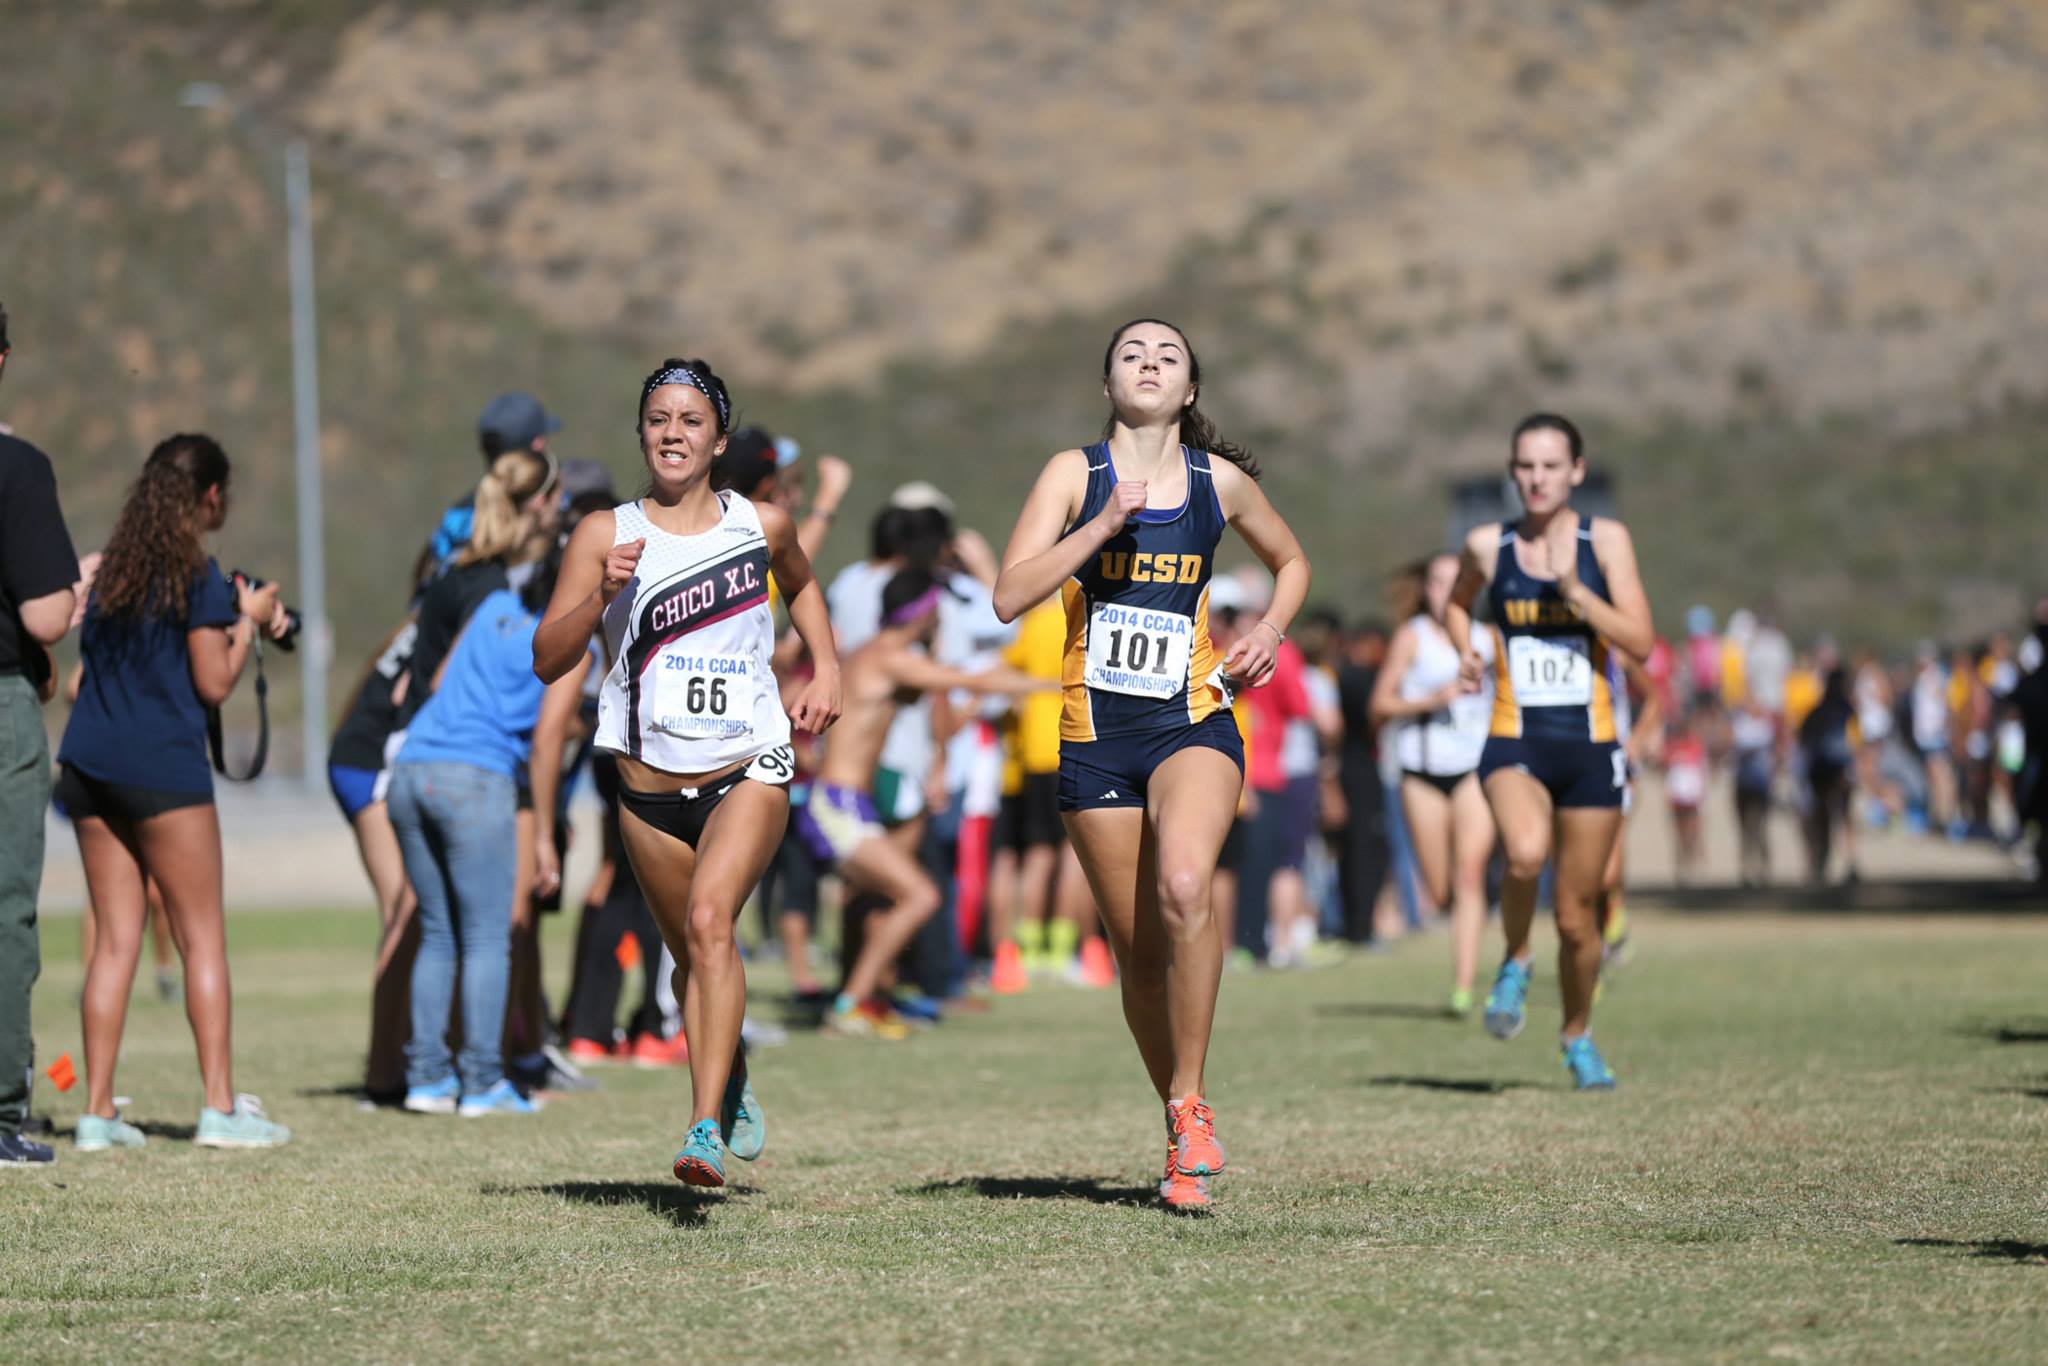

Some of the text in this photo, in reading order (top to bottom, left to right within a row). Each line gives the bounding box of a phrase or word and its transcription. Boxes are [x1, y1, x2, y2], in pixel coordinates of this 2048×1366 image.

[1100, 551, 1202, 584] UCSD
[652, 562, 760, 631] CHICO X.C.
[1098, 606, 1186, 635] 2014 CCAA
[665, 654, 747, 675] 2014 CCAA
[1106, 628, 1169, 675] 101
[1091, 667, 1178, 695] CHAMPIONSHIPS
[1529, 654, 1576, 684] 102
[686, 676, 727, 715] 66
[661, 715, 748, 734] CHAMPIONSHIPS
